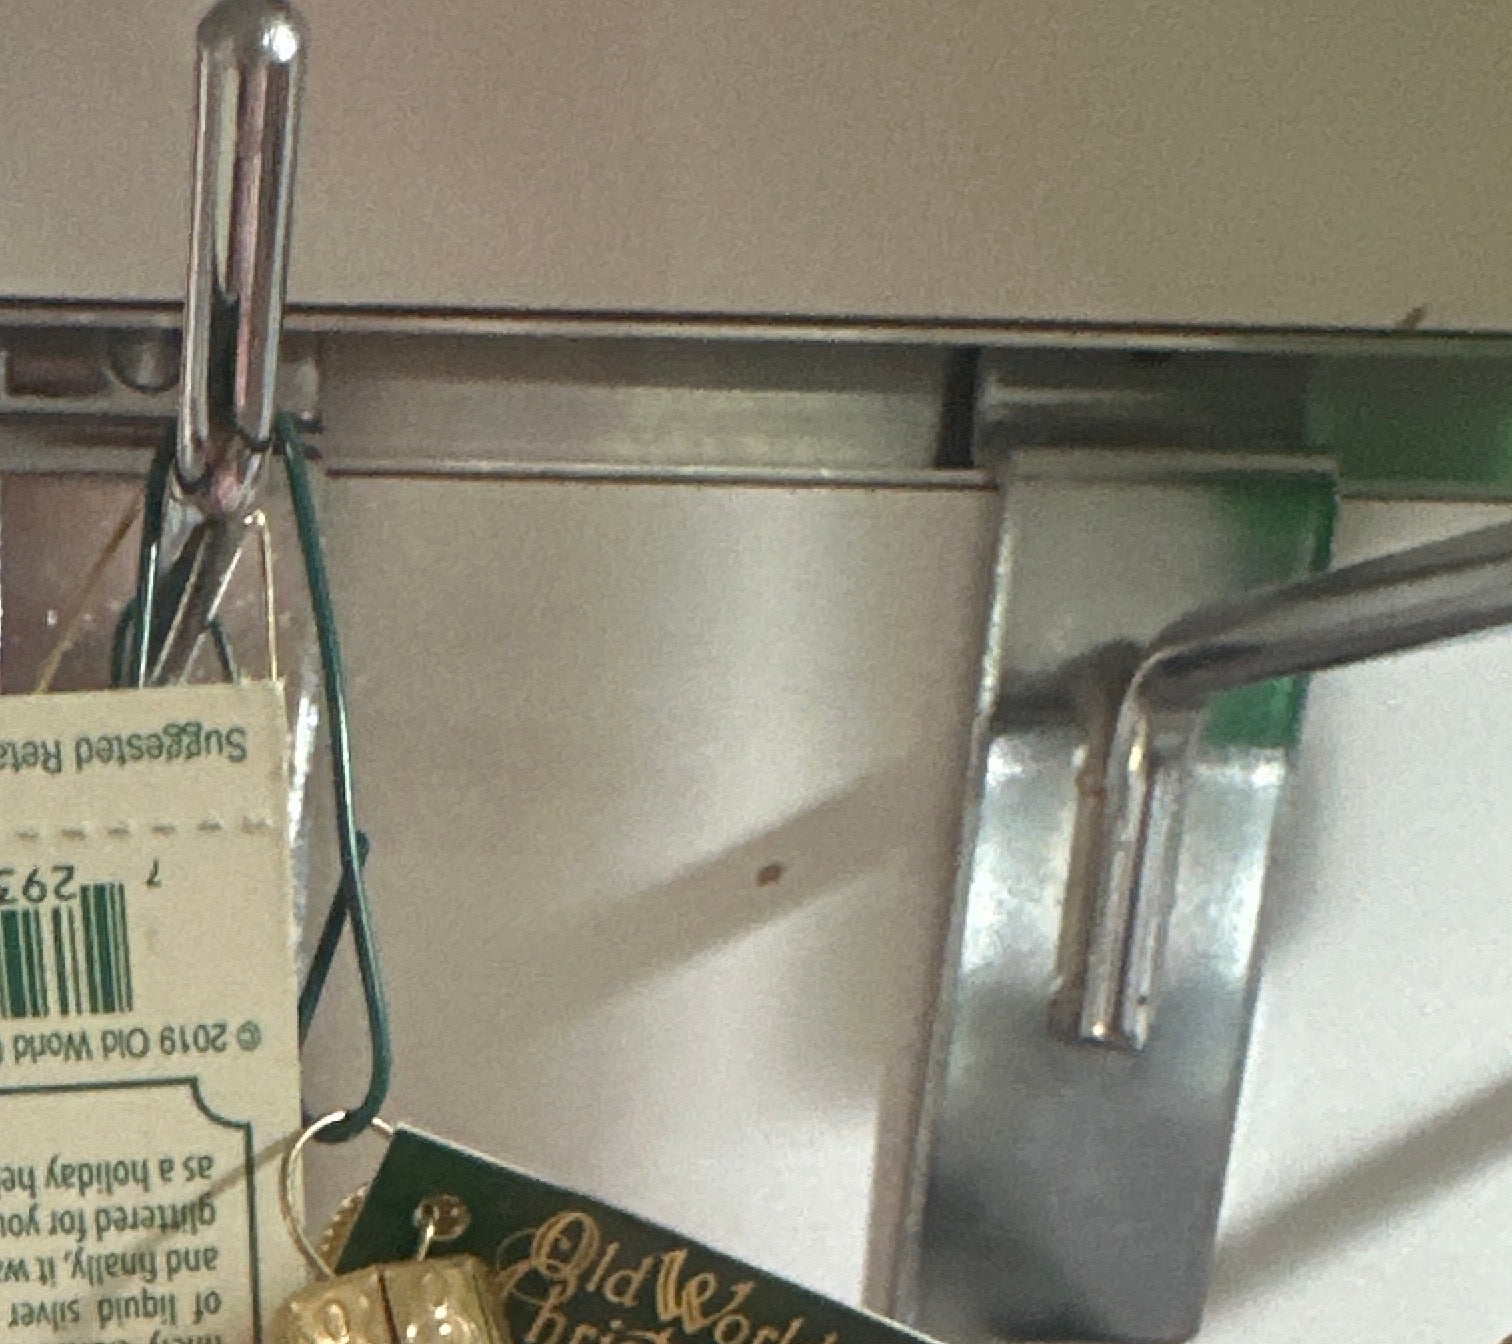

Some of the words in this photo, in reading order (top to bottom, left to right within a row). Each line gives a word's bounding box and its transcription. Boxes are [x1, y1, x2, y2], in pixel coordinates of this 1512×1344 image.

[74, 721, 248, 773] Suggested
[11, 1030, 94, 1066] World
[100, 1026, 151, 1061] Old
[158, 1021, 228, 1056] 2019
[44, 1153, 151, 1197] holiday
[157, 1155, 176, 1185] a
[181, 1153, 216, 1182] as
[48, 1206, 87, 1244] for
[94, 1194, 217, 1242] glittered
[37, 1255, 57, 1288] it
[63, 1246, 159, 1286] finally,
[166, 1246, 219, 1282] and
[500, 1210, 656, 1309] Old
[8, 1298, 81, 1332] silver
[96, 1287, 176, 1330] liquid
[191, 1289, 223, 1326] of
